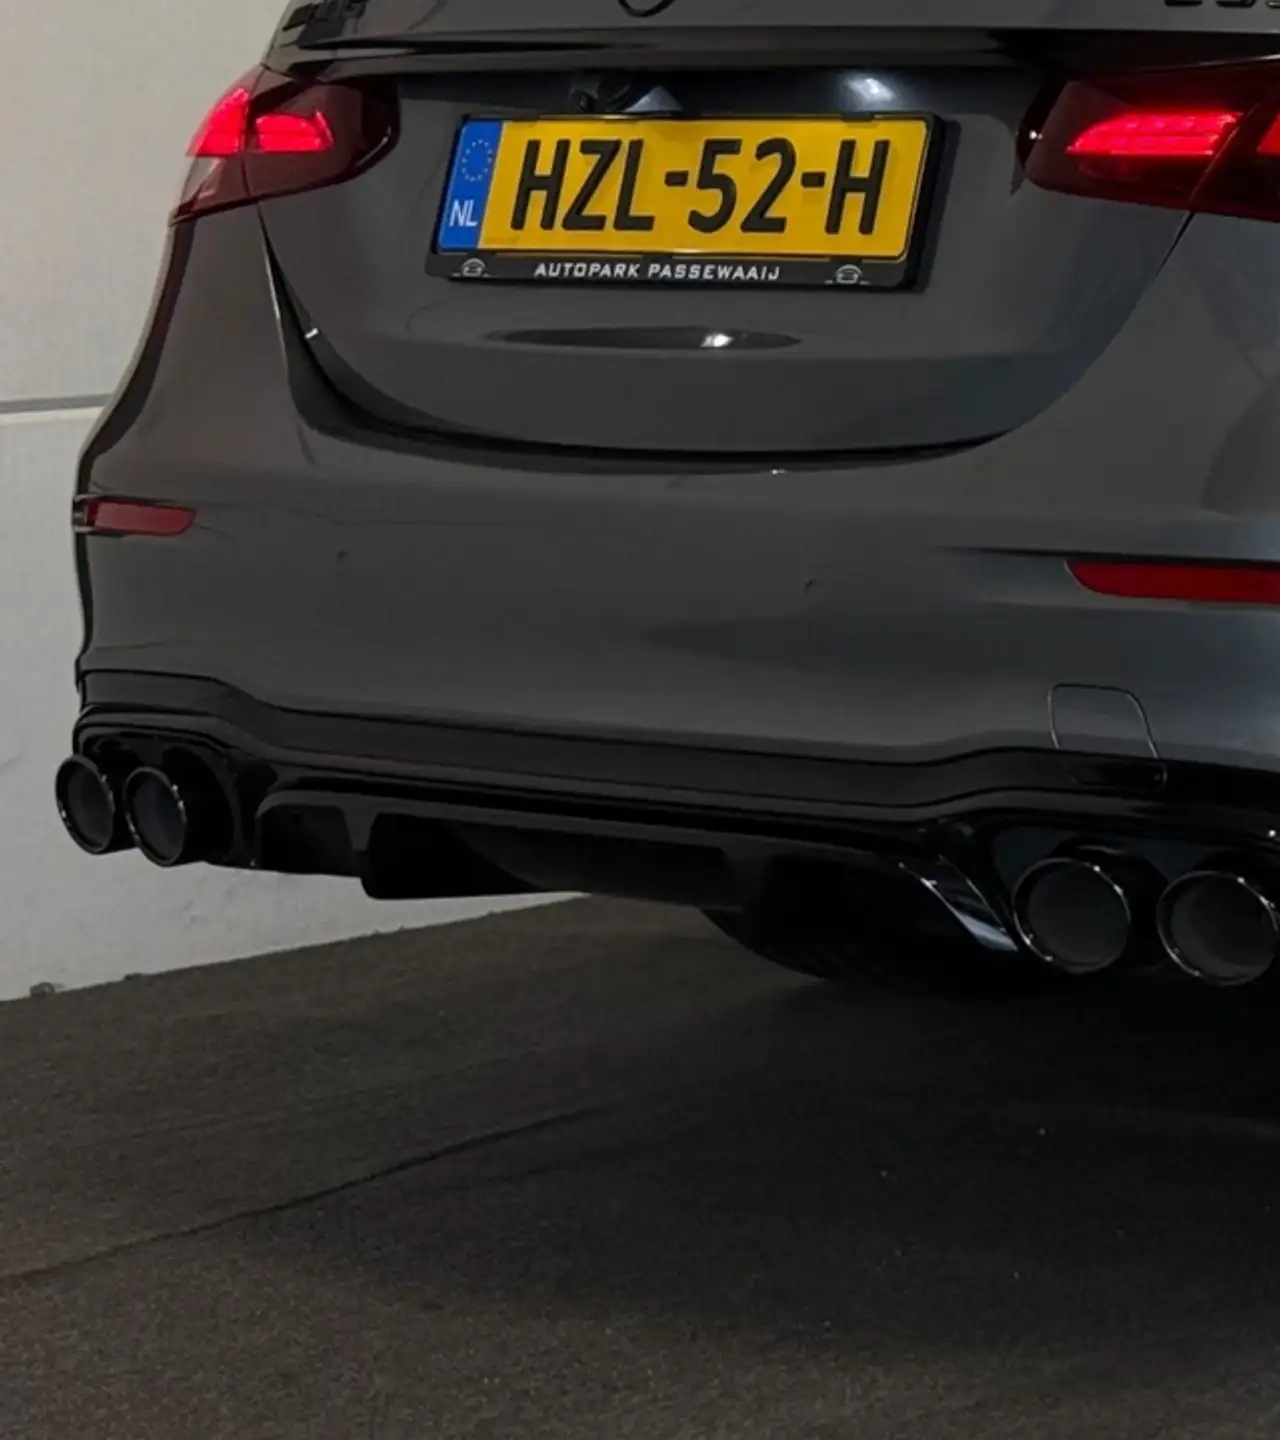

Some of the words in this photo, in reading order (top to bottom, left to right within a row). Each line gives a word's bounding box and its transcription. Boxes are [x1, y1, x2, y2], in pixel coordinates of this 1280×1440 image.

[510, 138, 890, 235] HZL-52-H
[448, 199, 478, 228] NL
[534, 262, 640, 278] AUTOPARK
[648, 263, 780, 280] PASSEWAAIJ
